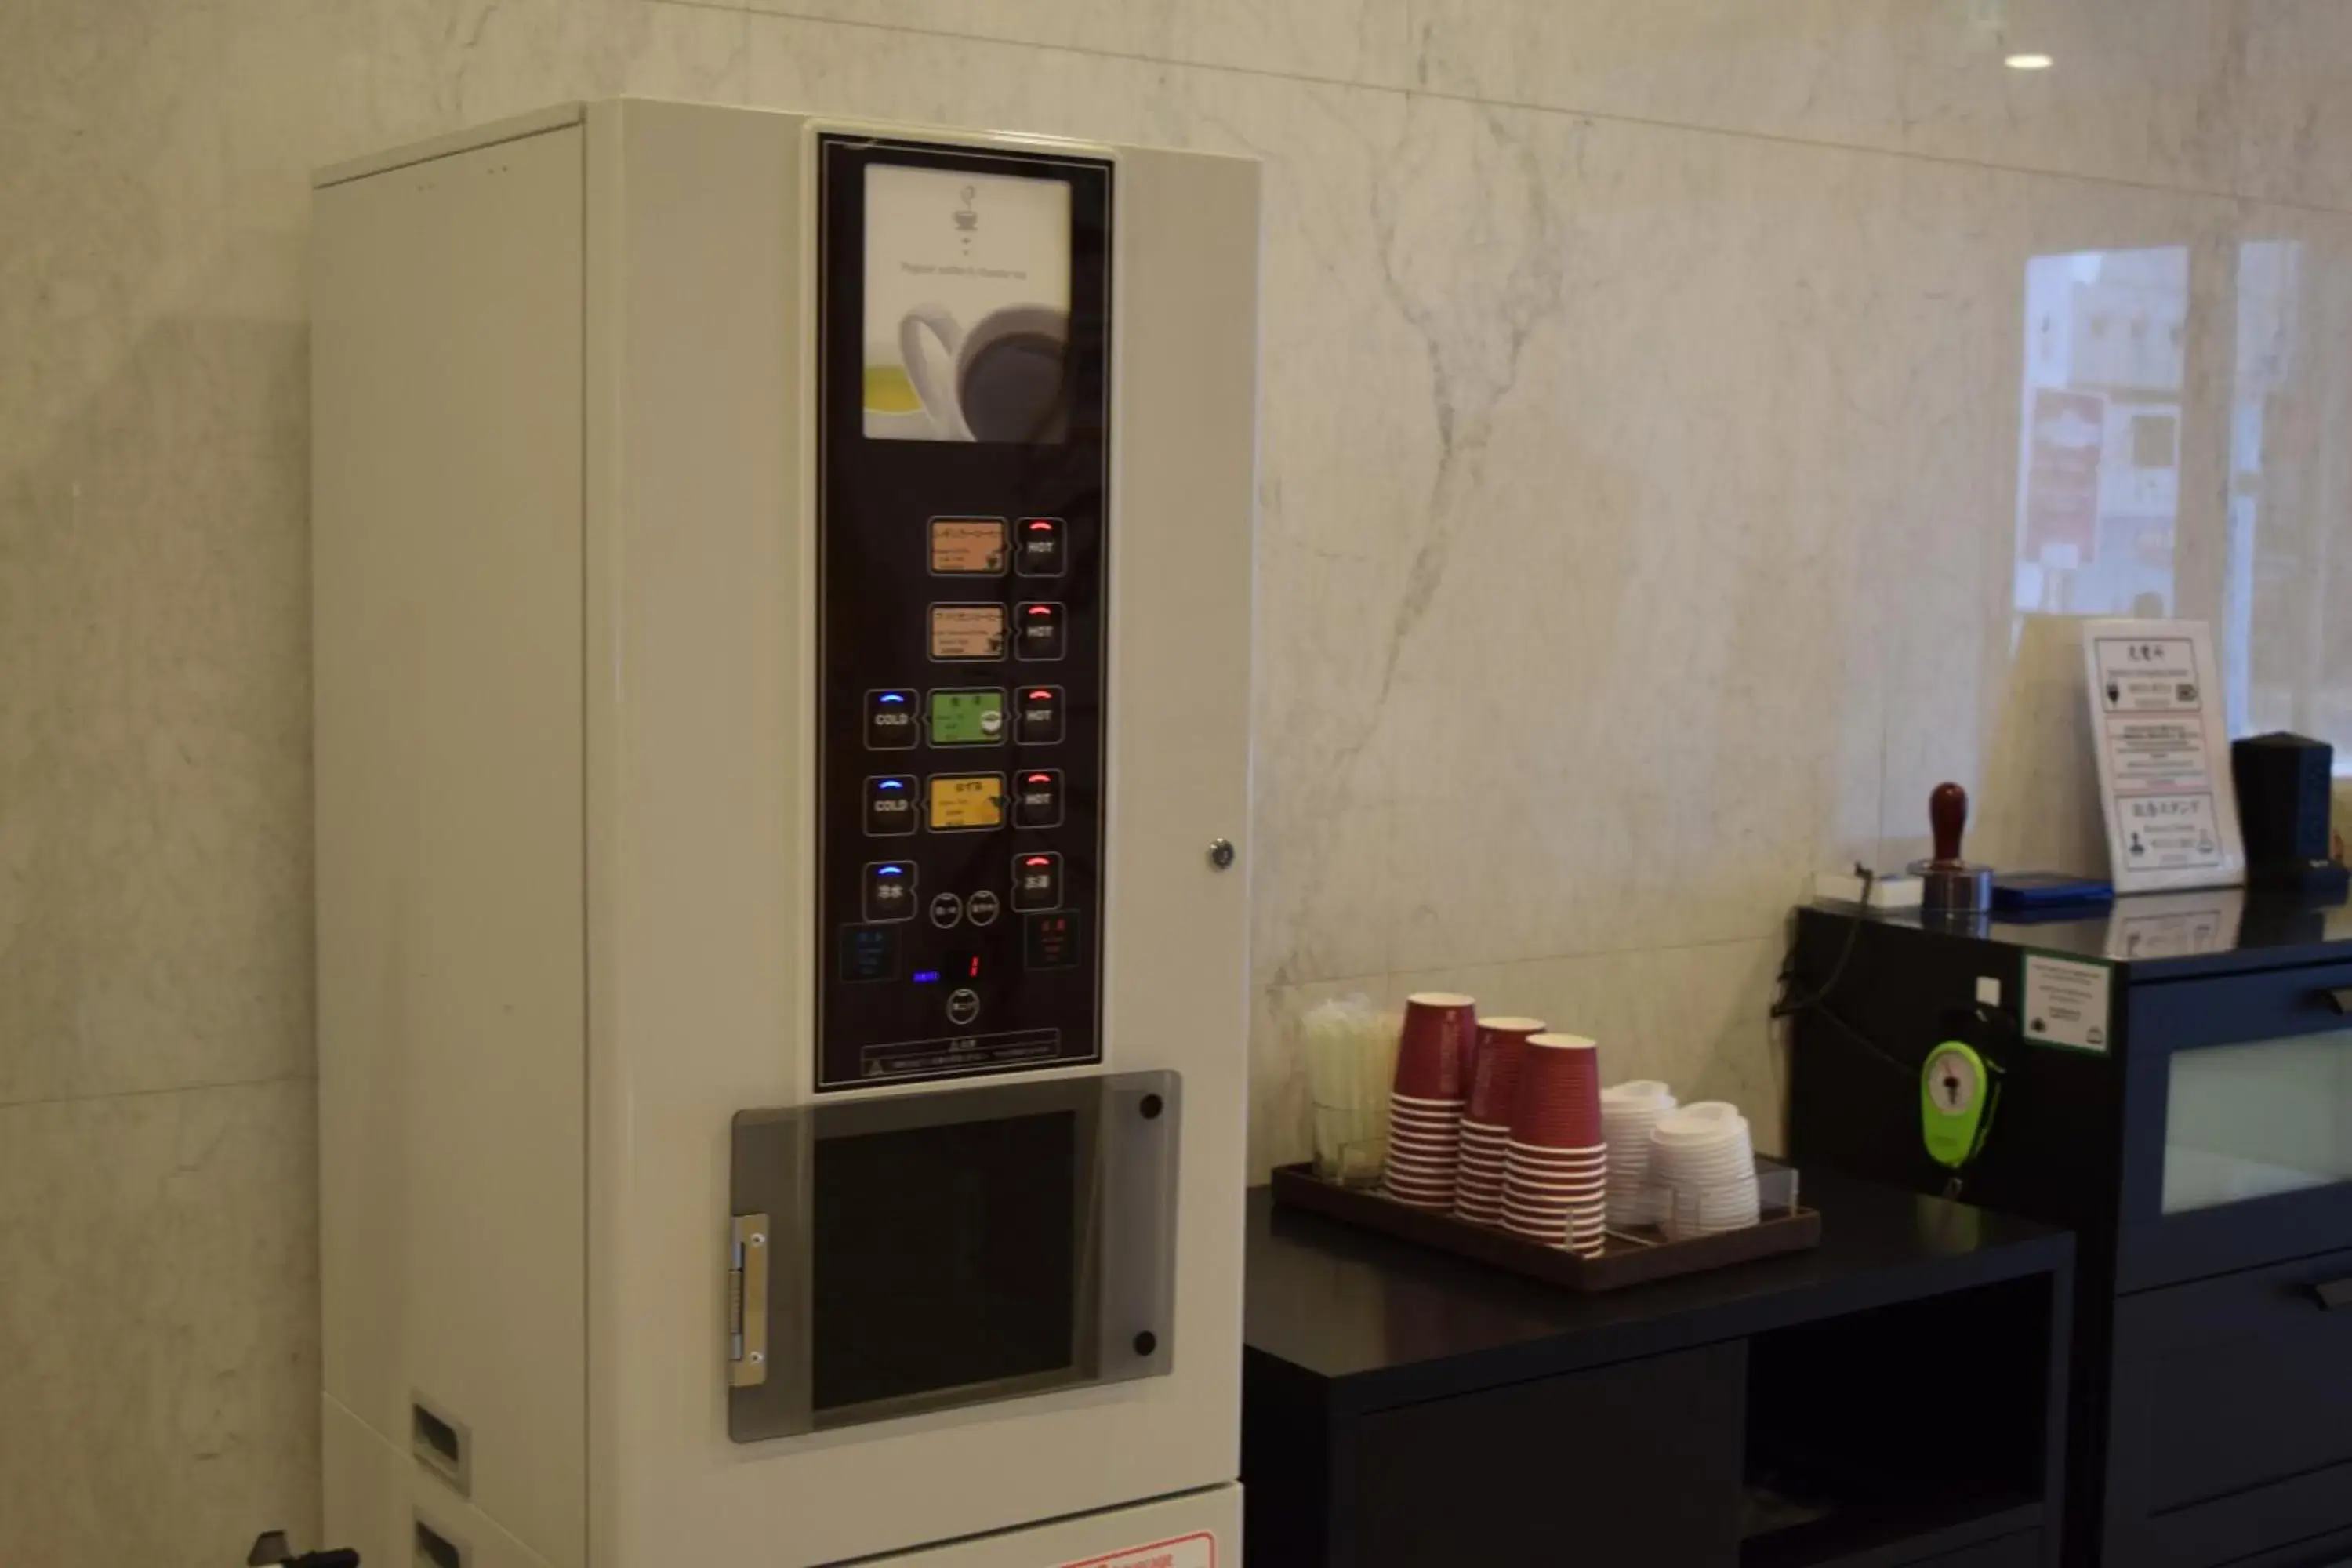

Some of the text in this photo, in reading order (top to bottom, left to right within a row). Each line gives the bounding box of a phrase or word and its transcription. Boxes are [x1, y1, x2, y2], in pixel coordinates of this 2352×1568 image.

[875, 713, 908, 725] COLD
[1025, 710, 1052, 720] HOT
[1025, 793, 1051, 804] HOT
[874, 800, 908, 811] COLD
